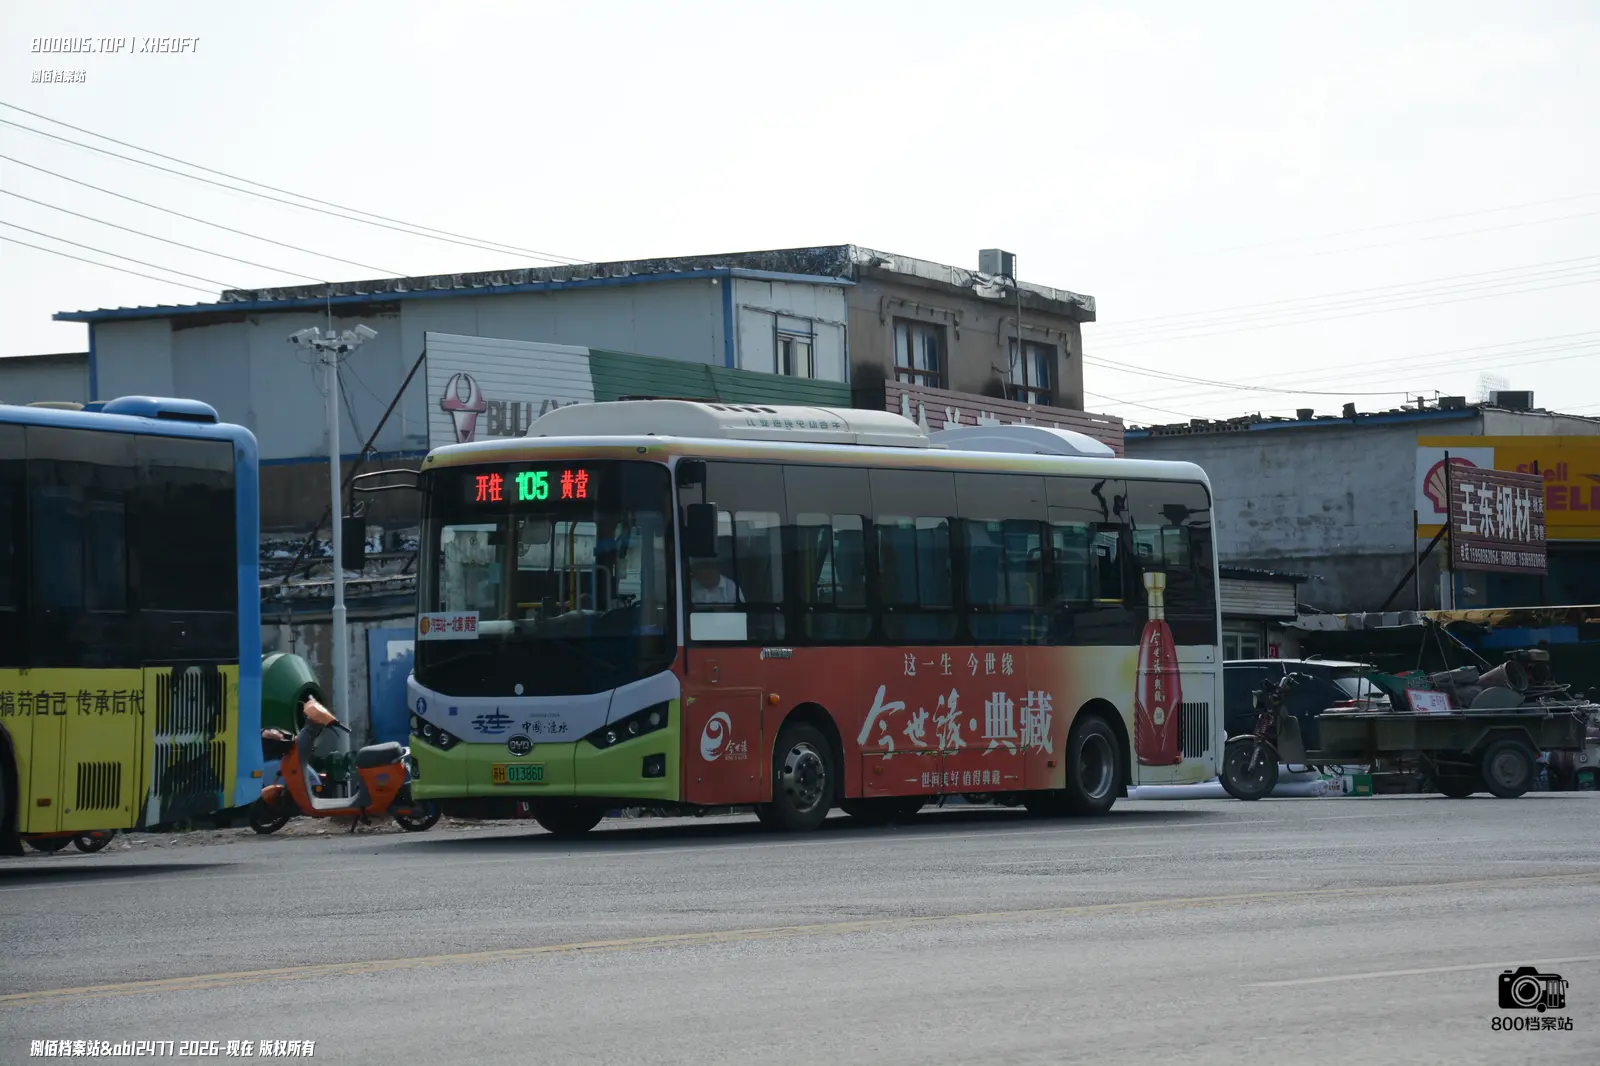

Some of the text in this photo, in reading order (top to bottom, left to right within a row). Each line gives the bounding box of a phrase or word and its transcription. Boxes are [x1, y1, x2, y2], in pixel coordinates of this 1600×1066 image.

[475, 469, 589, 502] 开往 105 黄营
[1460, 481, 1531, 543] 王东钢材
[904, 652, 1013, 676] 这一生 今世缘
[76, 689, 145, 716] 传承后代
[509, 740, 531, 750] BYD
[921, 771, 960, 788] 世间美好
